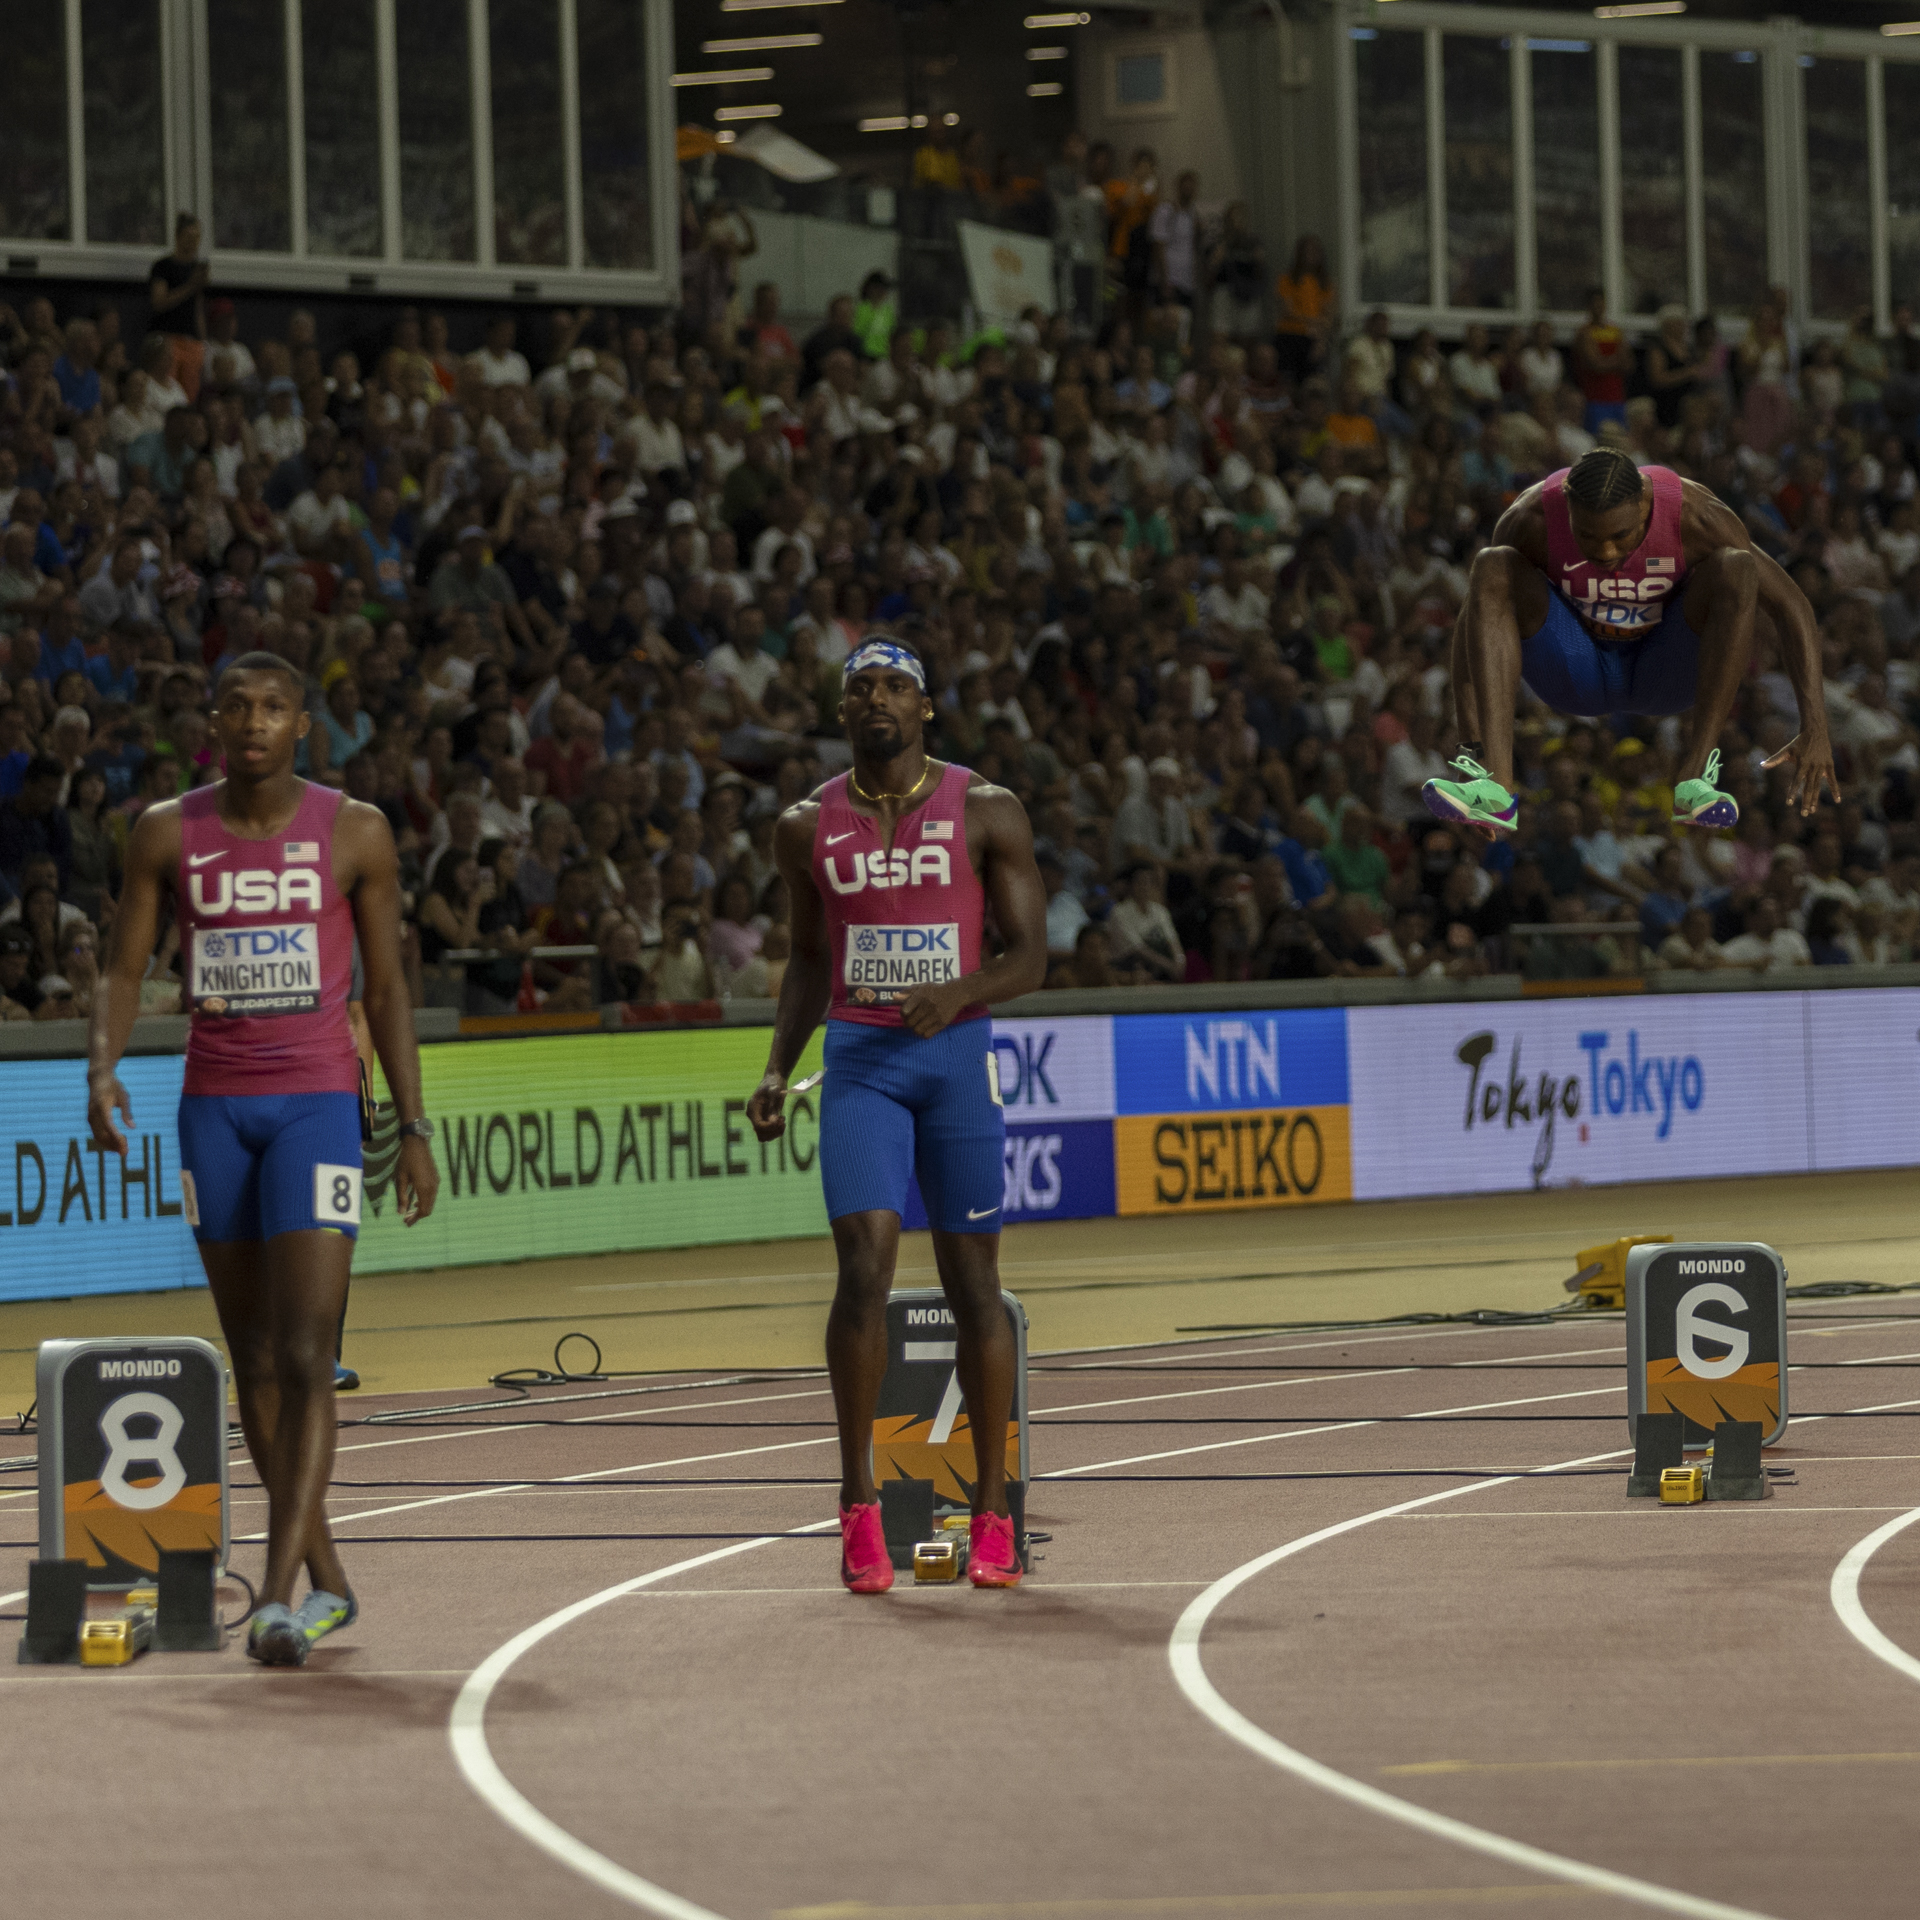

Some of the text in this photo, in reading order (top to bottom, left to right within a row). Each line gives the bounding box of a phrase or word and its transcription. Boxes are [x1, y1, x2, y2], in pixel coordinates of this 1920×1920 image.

[189, 868, 322, 916] USA
[824, 845, 952, 895] USA
[225, 928, 309, 957] TDK
[877, 928, 952, 952] TDK
[200, 960, 312, 991] KNIGHTON
[851, 957, 955, 984] BEDNAREK
[992, 1032, 1059, 1105] DK
[1185, 1017, 1280, 1102] NTN
[1455, 1029, 1704, 1190] Tokyo Tokyo
[441, 1106, 604, 1197] WORLD
[1153, 1113, 1325, 1205] SEIKO
[331, 1173, 352, 1214] 8
[1678, 1259, 1747, 1275] MONDO
[907, 1308, 956, 1325] MON
[1676, 1282, 1750, 1380] 6
[100, 1358, 182, 1379] MONDO
[904, 1341, 964, 1444] 7
[100, 1391, 188, 1510] 8
